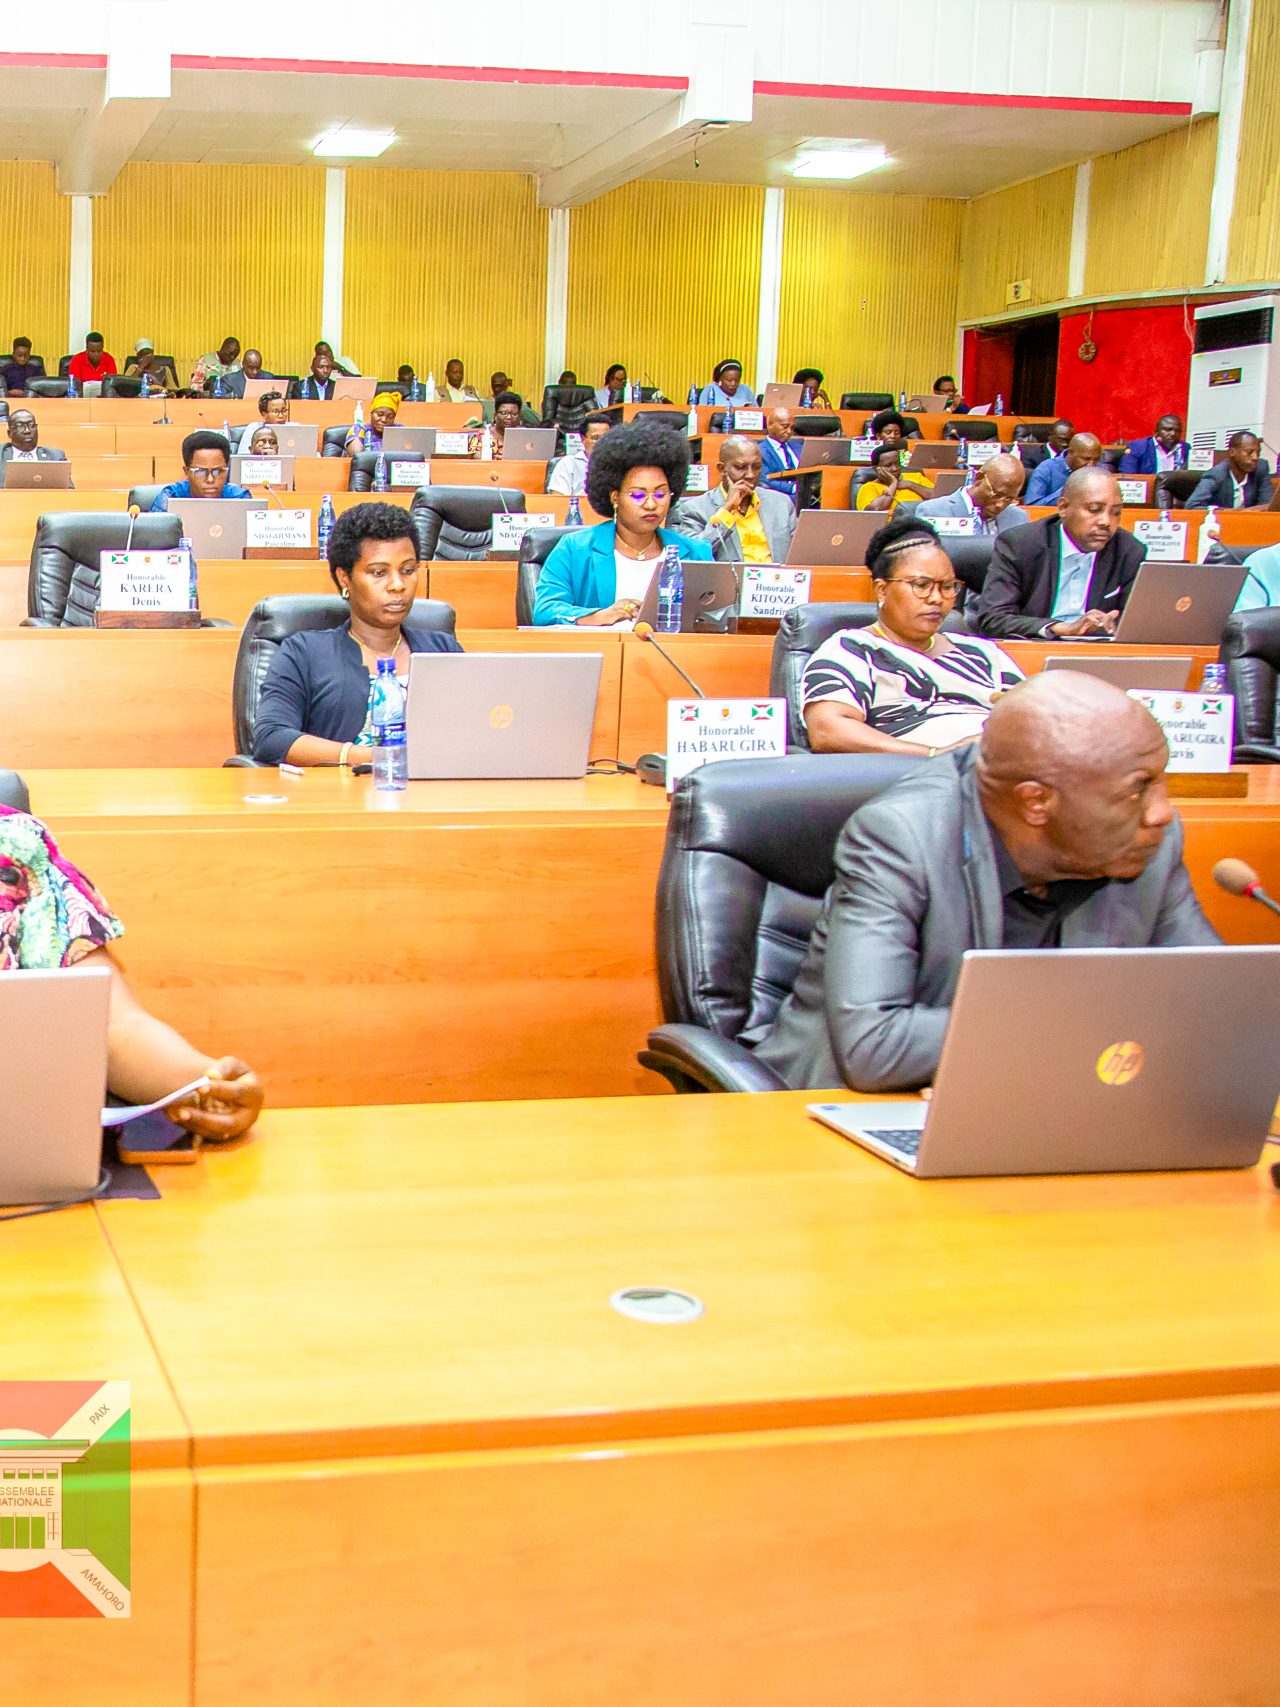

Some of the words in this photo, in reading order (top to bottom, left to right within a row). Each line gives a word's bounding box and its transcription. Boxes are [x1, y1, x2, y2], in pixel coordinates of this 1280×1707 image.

[126, 573, 166, 581] Honorable
[120, 583, 173, 593] KARERA
[755, 583, 795, 593] Honorable
[132, 596, 161, 606] Denis
[751, 593, 797, 605] KITONZE
[752, 605, 788, 616] Sandrin
[1160, 718, 1207, 730] onorable
[698, 724, 756, 736] Honorable
[1173, 733, 1226, 745] ARUGIRA
[677, 739, 777, 753] HABARUGIRA
